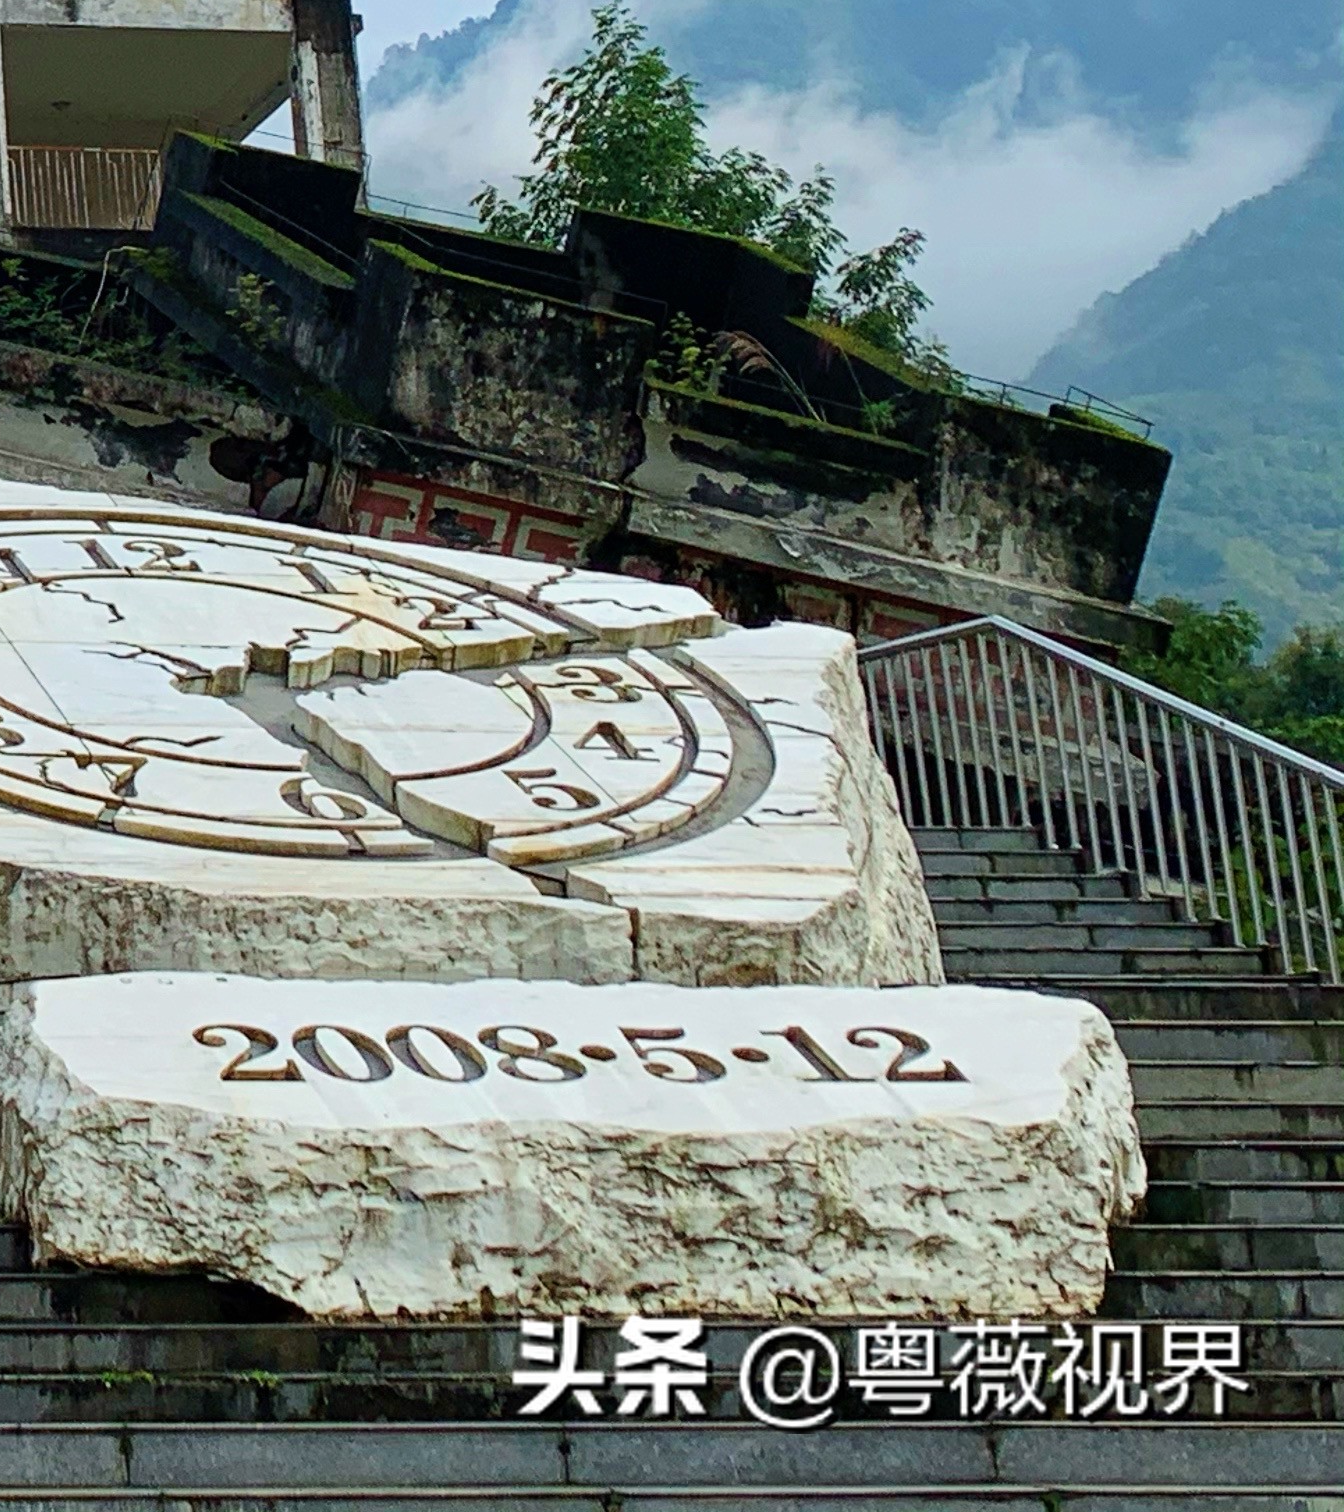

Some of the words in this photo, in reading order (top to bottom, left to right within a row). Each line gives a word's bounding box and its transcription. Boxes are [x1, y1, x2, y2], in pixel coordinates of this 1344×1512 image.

[63, 538, 203, 573] 12
[274, 557, 358, 595] 1
[395, 594, 482, 631] 2
[556, 665, 643, 703] 3
[573, 721, 660, 762] 4
[67, 750, 148, 797] 7
[501, 768, 602, 811] 5
[279, 775, 368, 820] 6
